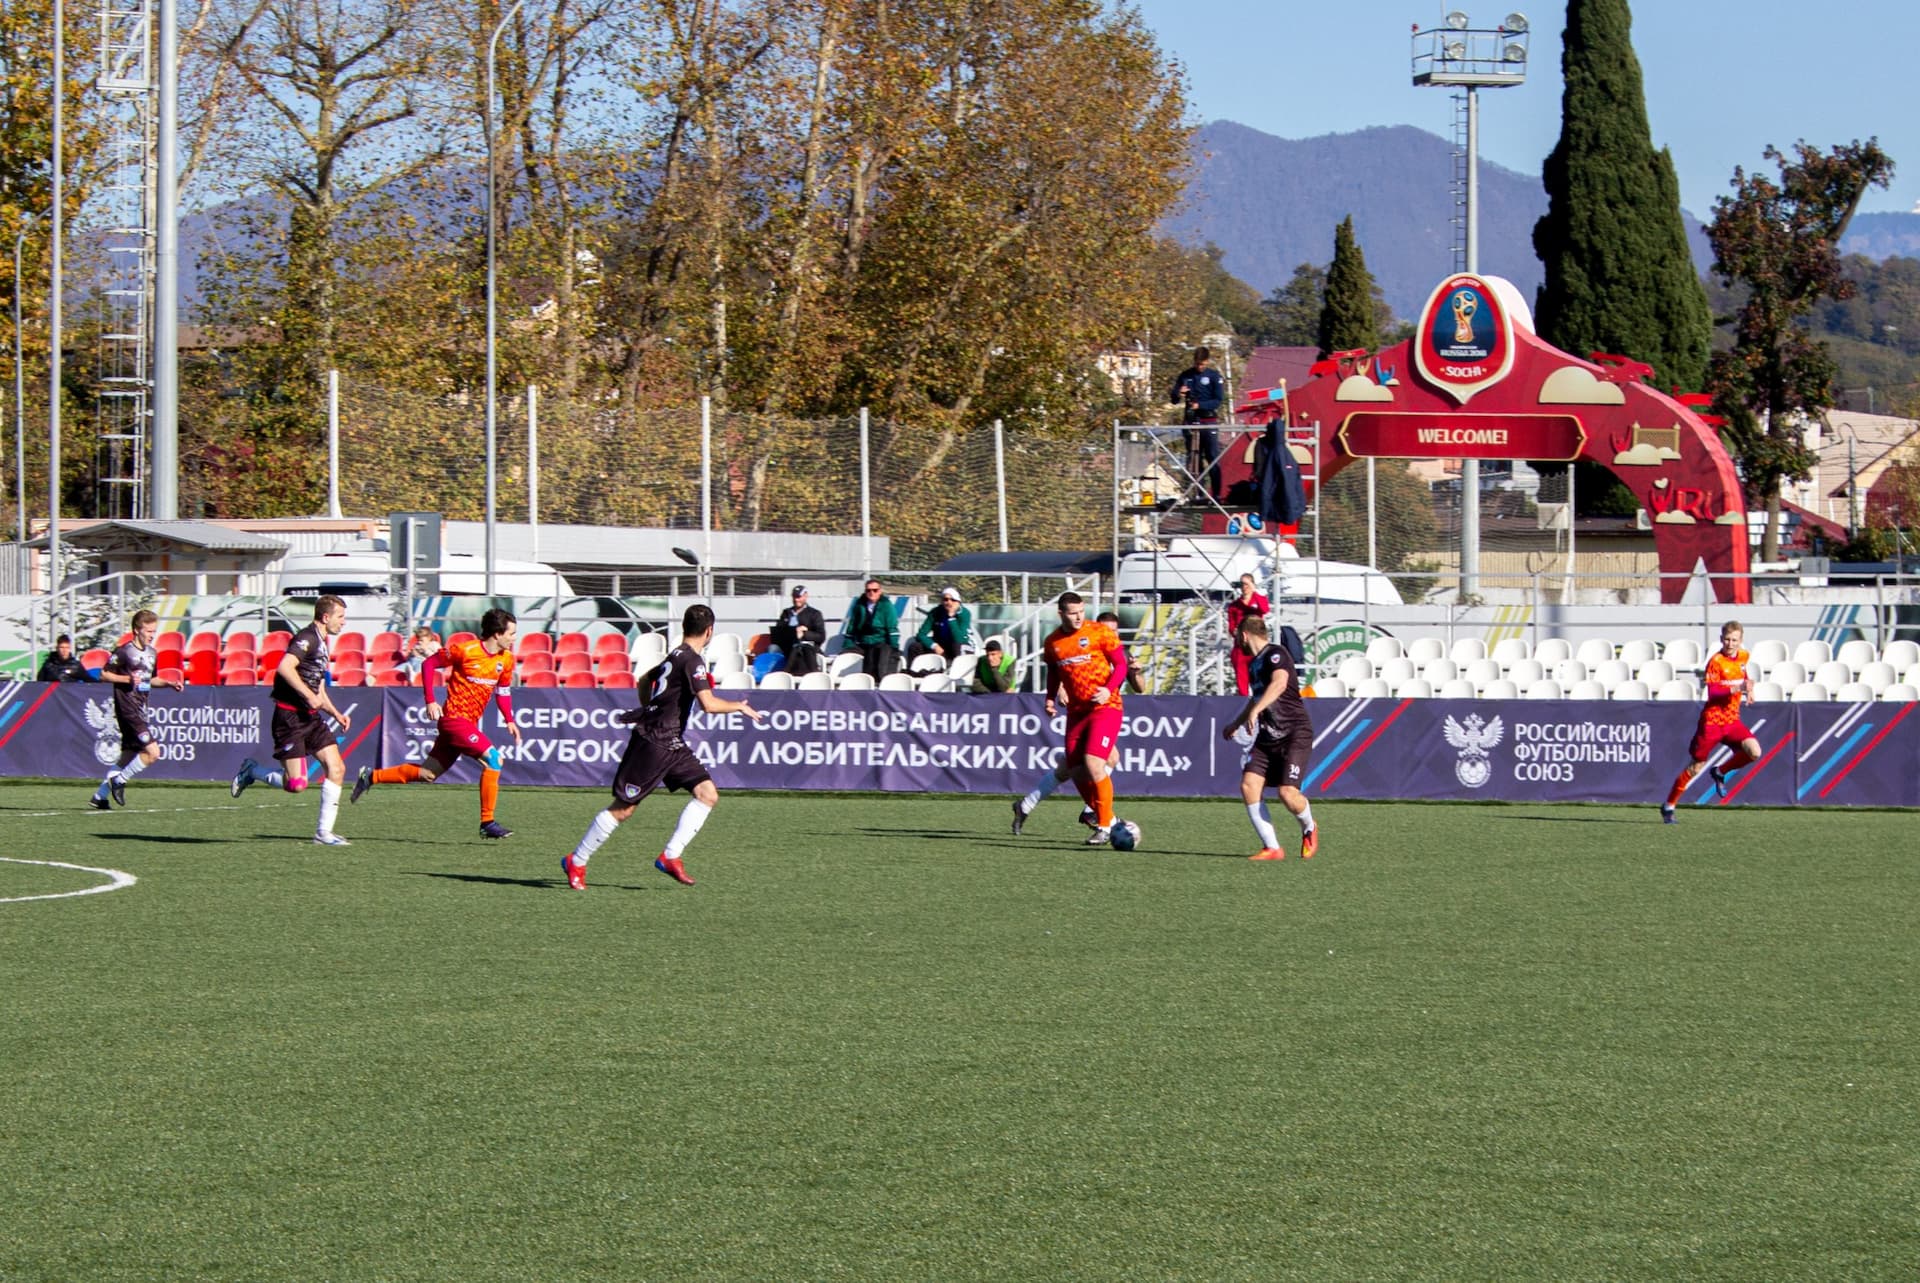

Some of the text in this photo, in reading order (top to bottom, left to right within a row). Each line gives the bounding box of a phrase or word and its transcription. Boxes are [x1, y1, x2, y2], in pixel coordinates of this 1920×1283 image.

[1445, 366, 1482, 378] SOCHI
[1417, 428, 1508, 444] WELCOME!
[147, 705, 260, 725] РОССИЙСКИЙ
[752, 709, 990, 734] СОРЕВНОВАНИЯ
[999, 713, 1041, 735] ПО
[1050, 713, 1193, 738] ФБОЛУ
[1514, 721, 1650, 743] РОССИЙСКИЙ
[158, 744, 196, 761] ОЮЗ
[748, 741, 1017, 770] ЛЮБИТЕЛЬСКИХ
[1027, 746, 1192, 777] КОНД»
[1514, 742, 1650, 763] ФУТБОЛЬНЫЙ
[1514, 763, 1574, 781] СОЮЗ
